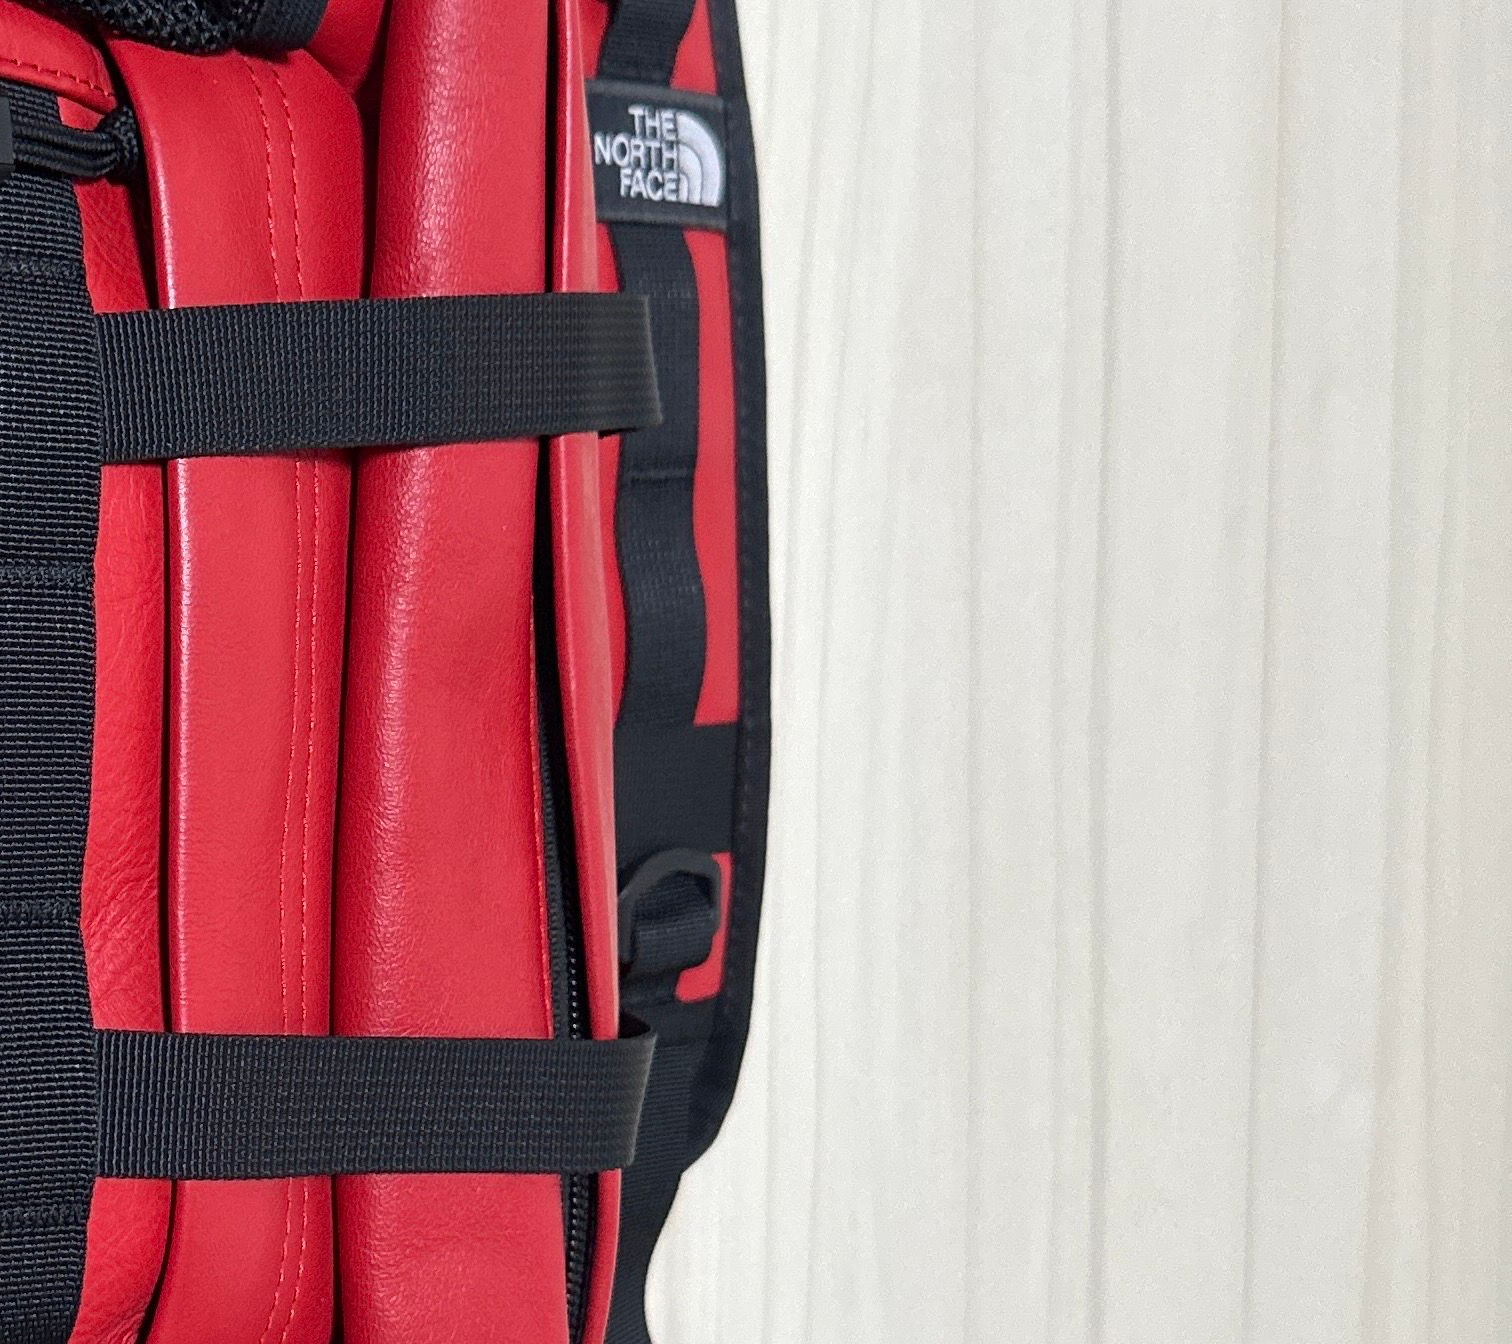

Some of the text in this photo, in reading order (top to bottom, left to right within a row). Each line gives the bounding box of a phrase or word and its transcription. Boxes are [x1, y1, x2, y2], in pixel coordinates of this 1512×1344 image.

[628, 105, 677, 141] THE
[593, 132, 678, 172] NORTH
[620, 167, 678, 202] FACE
